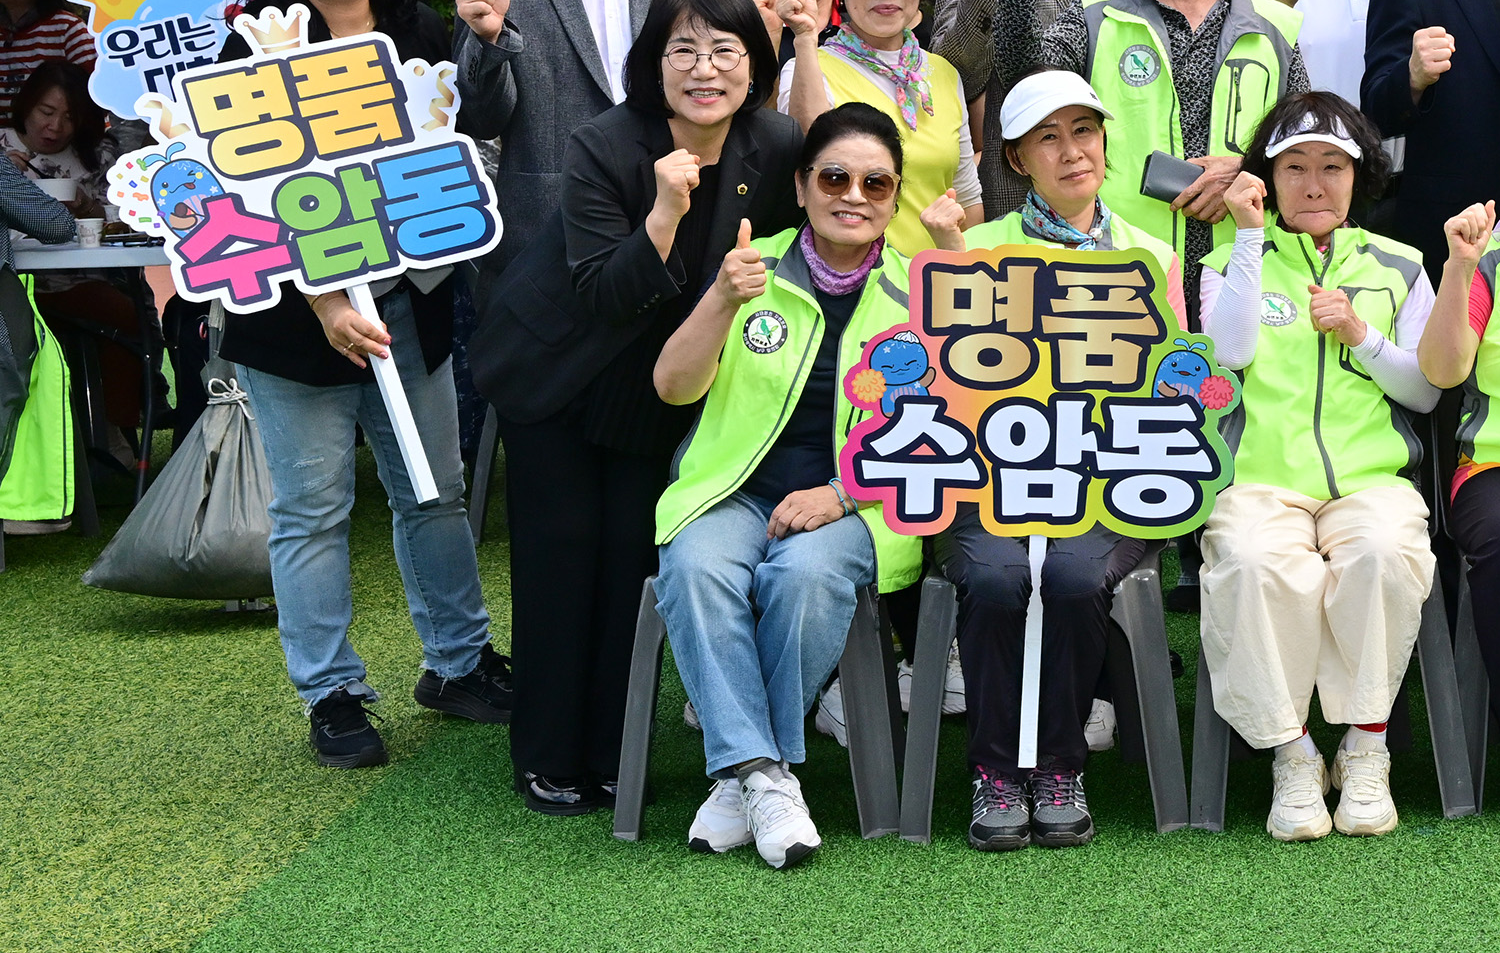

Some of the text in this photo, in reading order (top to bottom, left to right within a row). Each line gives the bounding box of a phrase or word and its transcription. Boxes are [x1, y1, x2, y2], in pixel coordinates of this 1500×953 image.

[107, 16, 216, 67] 우리는
[184, 42, 409, 179] 명품
[178, 145, 488, 301] 수암동
[929, 263, 1160, 387] 명품
[860, 398, 1214, 520] 수암동
